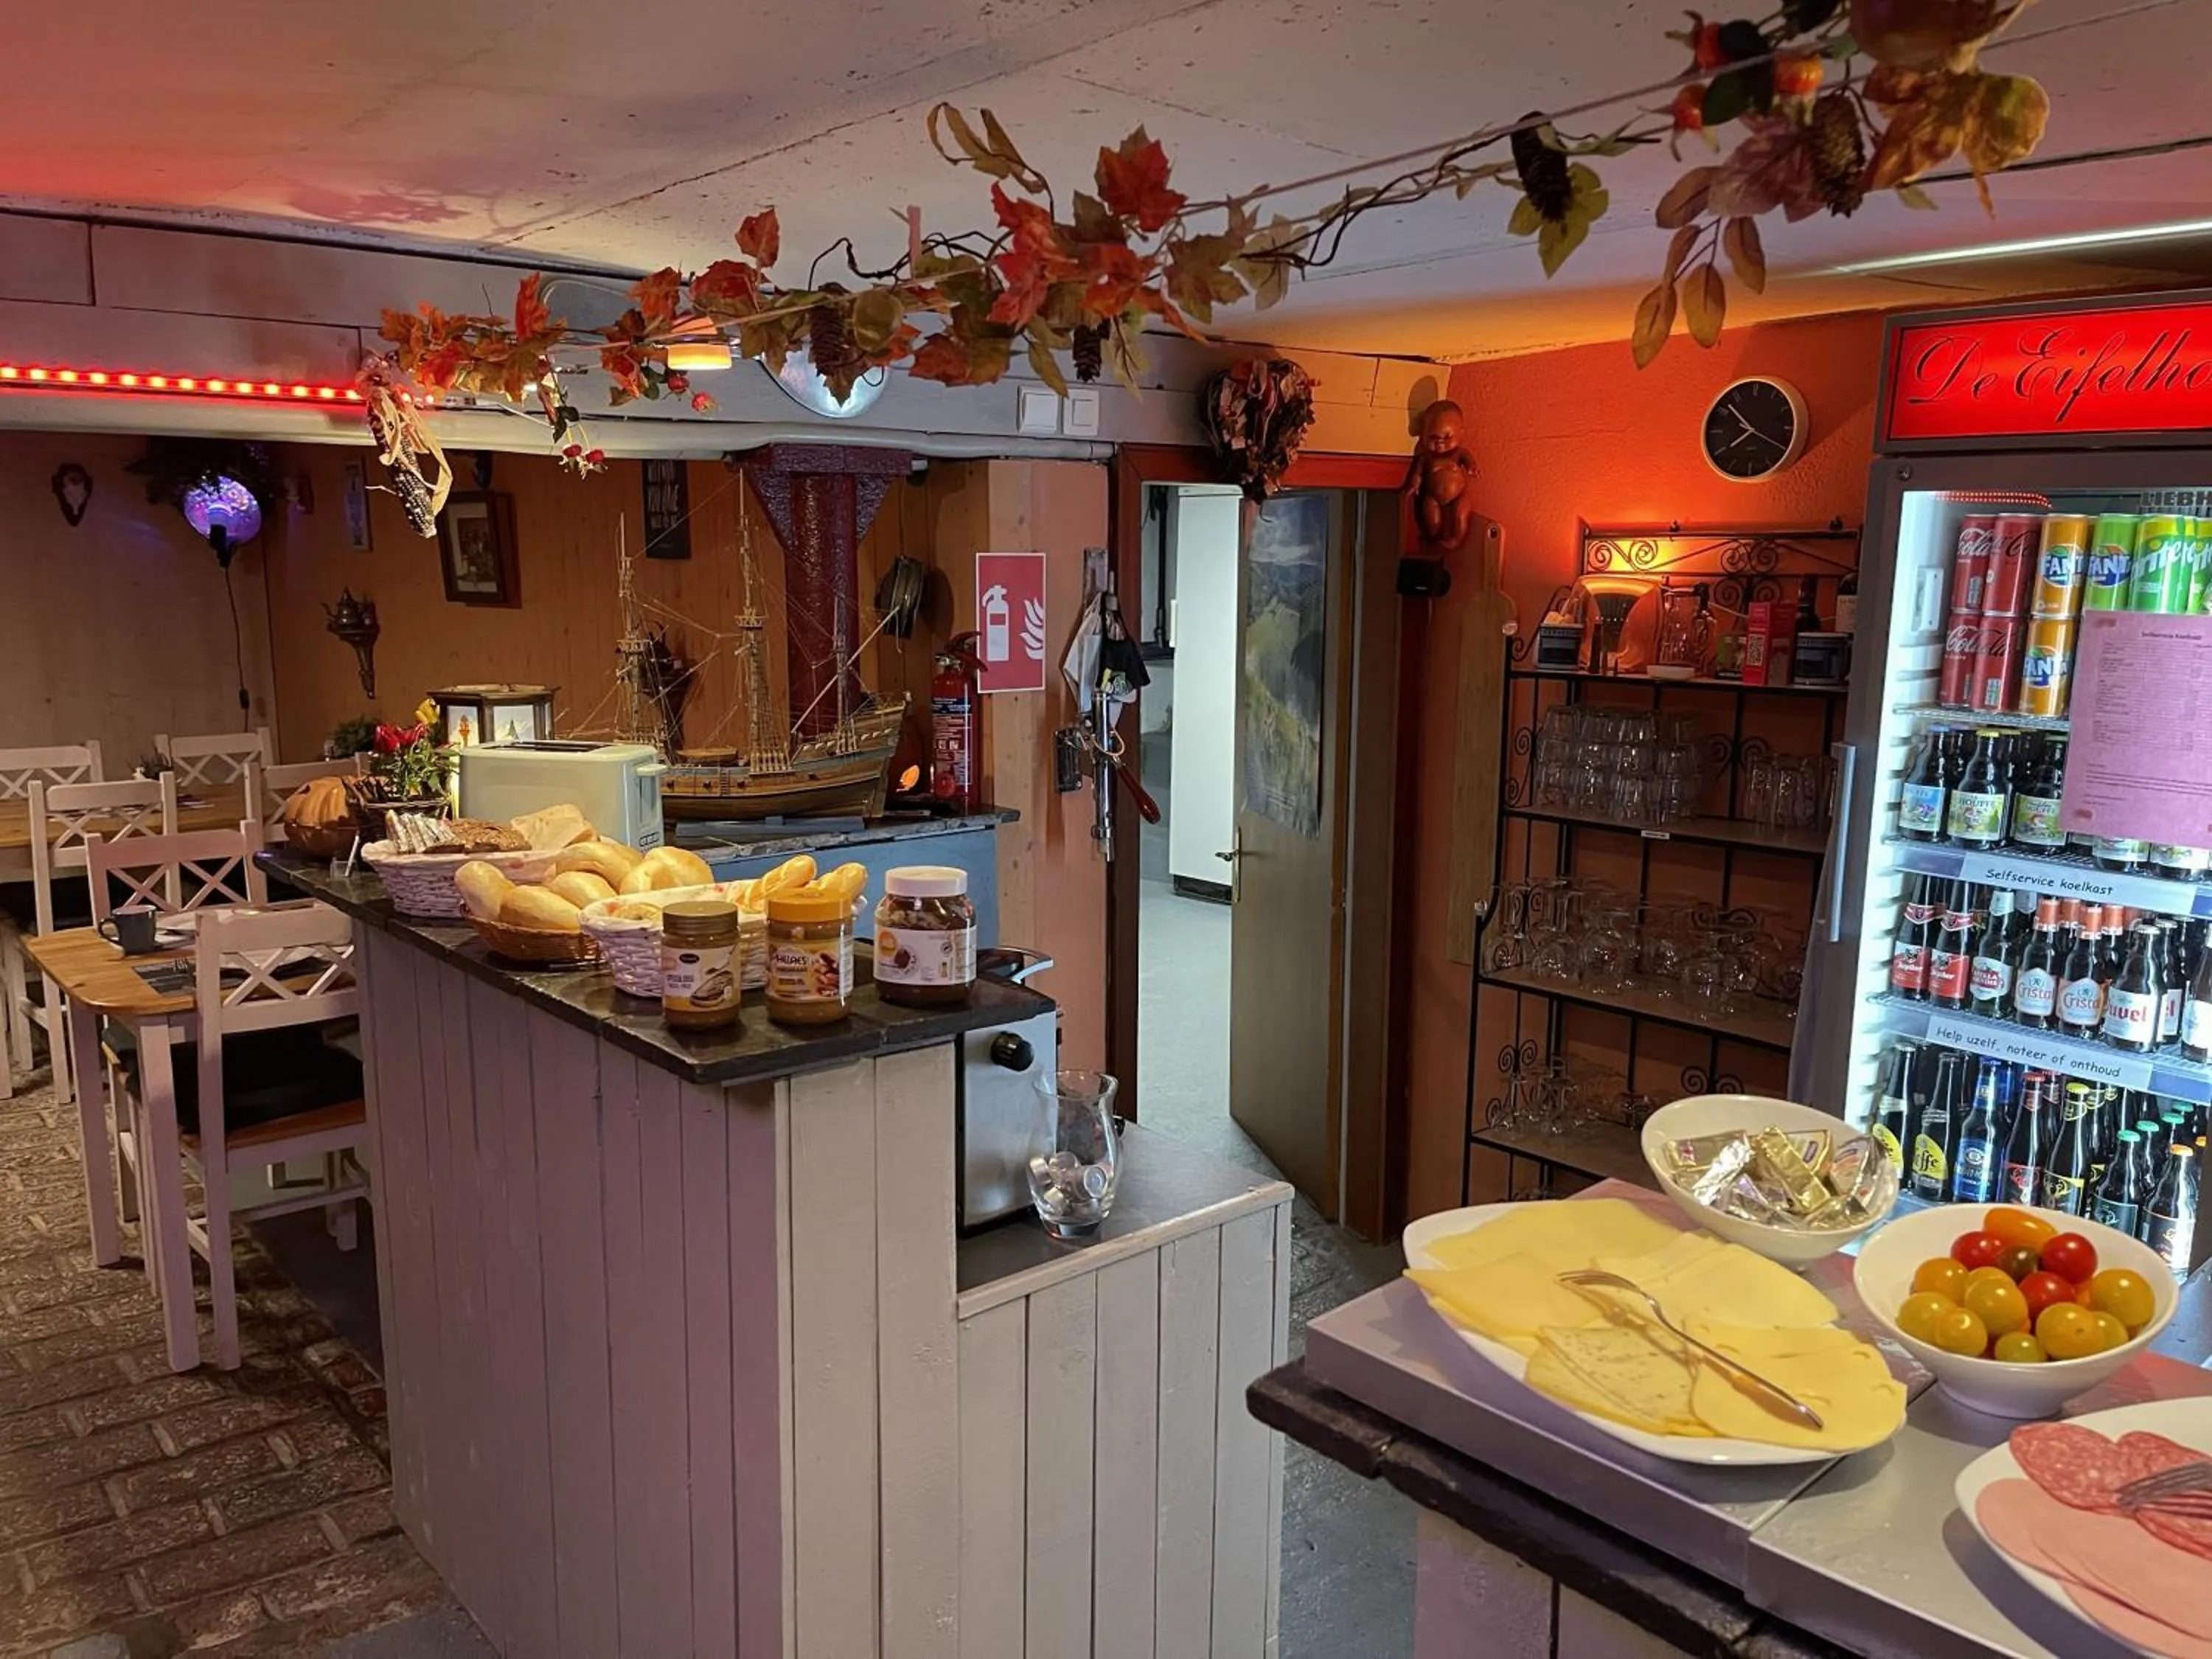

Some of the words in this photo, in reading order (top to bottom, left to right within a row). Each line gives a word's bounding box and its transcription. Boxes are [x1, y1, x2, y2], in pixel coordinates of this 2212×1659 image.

[1907, 334, 1997, 403] De
[2088, 554, 2132, 574] FANT
[1986, 869, 2055, 887] Selfservice
[2060, 878, 2113, 895] koelkast
[2017, 981, 2053, 999] Crista
[2109, 1004, 2147, 1022] uvel
[1936, 1026, 1962, 1043] Help
[2007, 1044, 2046, 1060] noteer
[2051, 1057, 2067, 1068] of
[2070, 1062, 2121, 1077] onthoud
